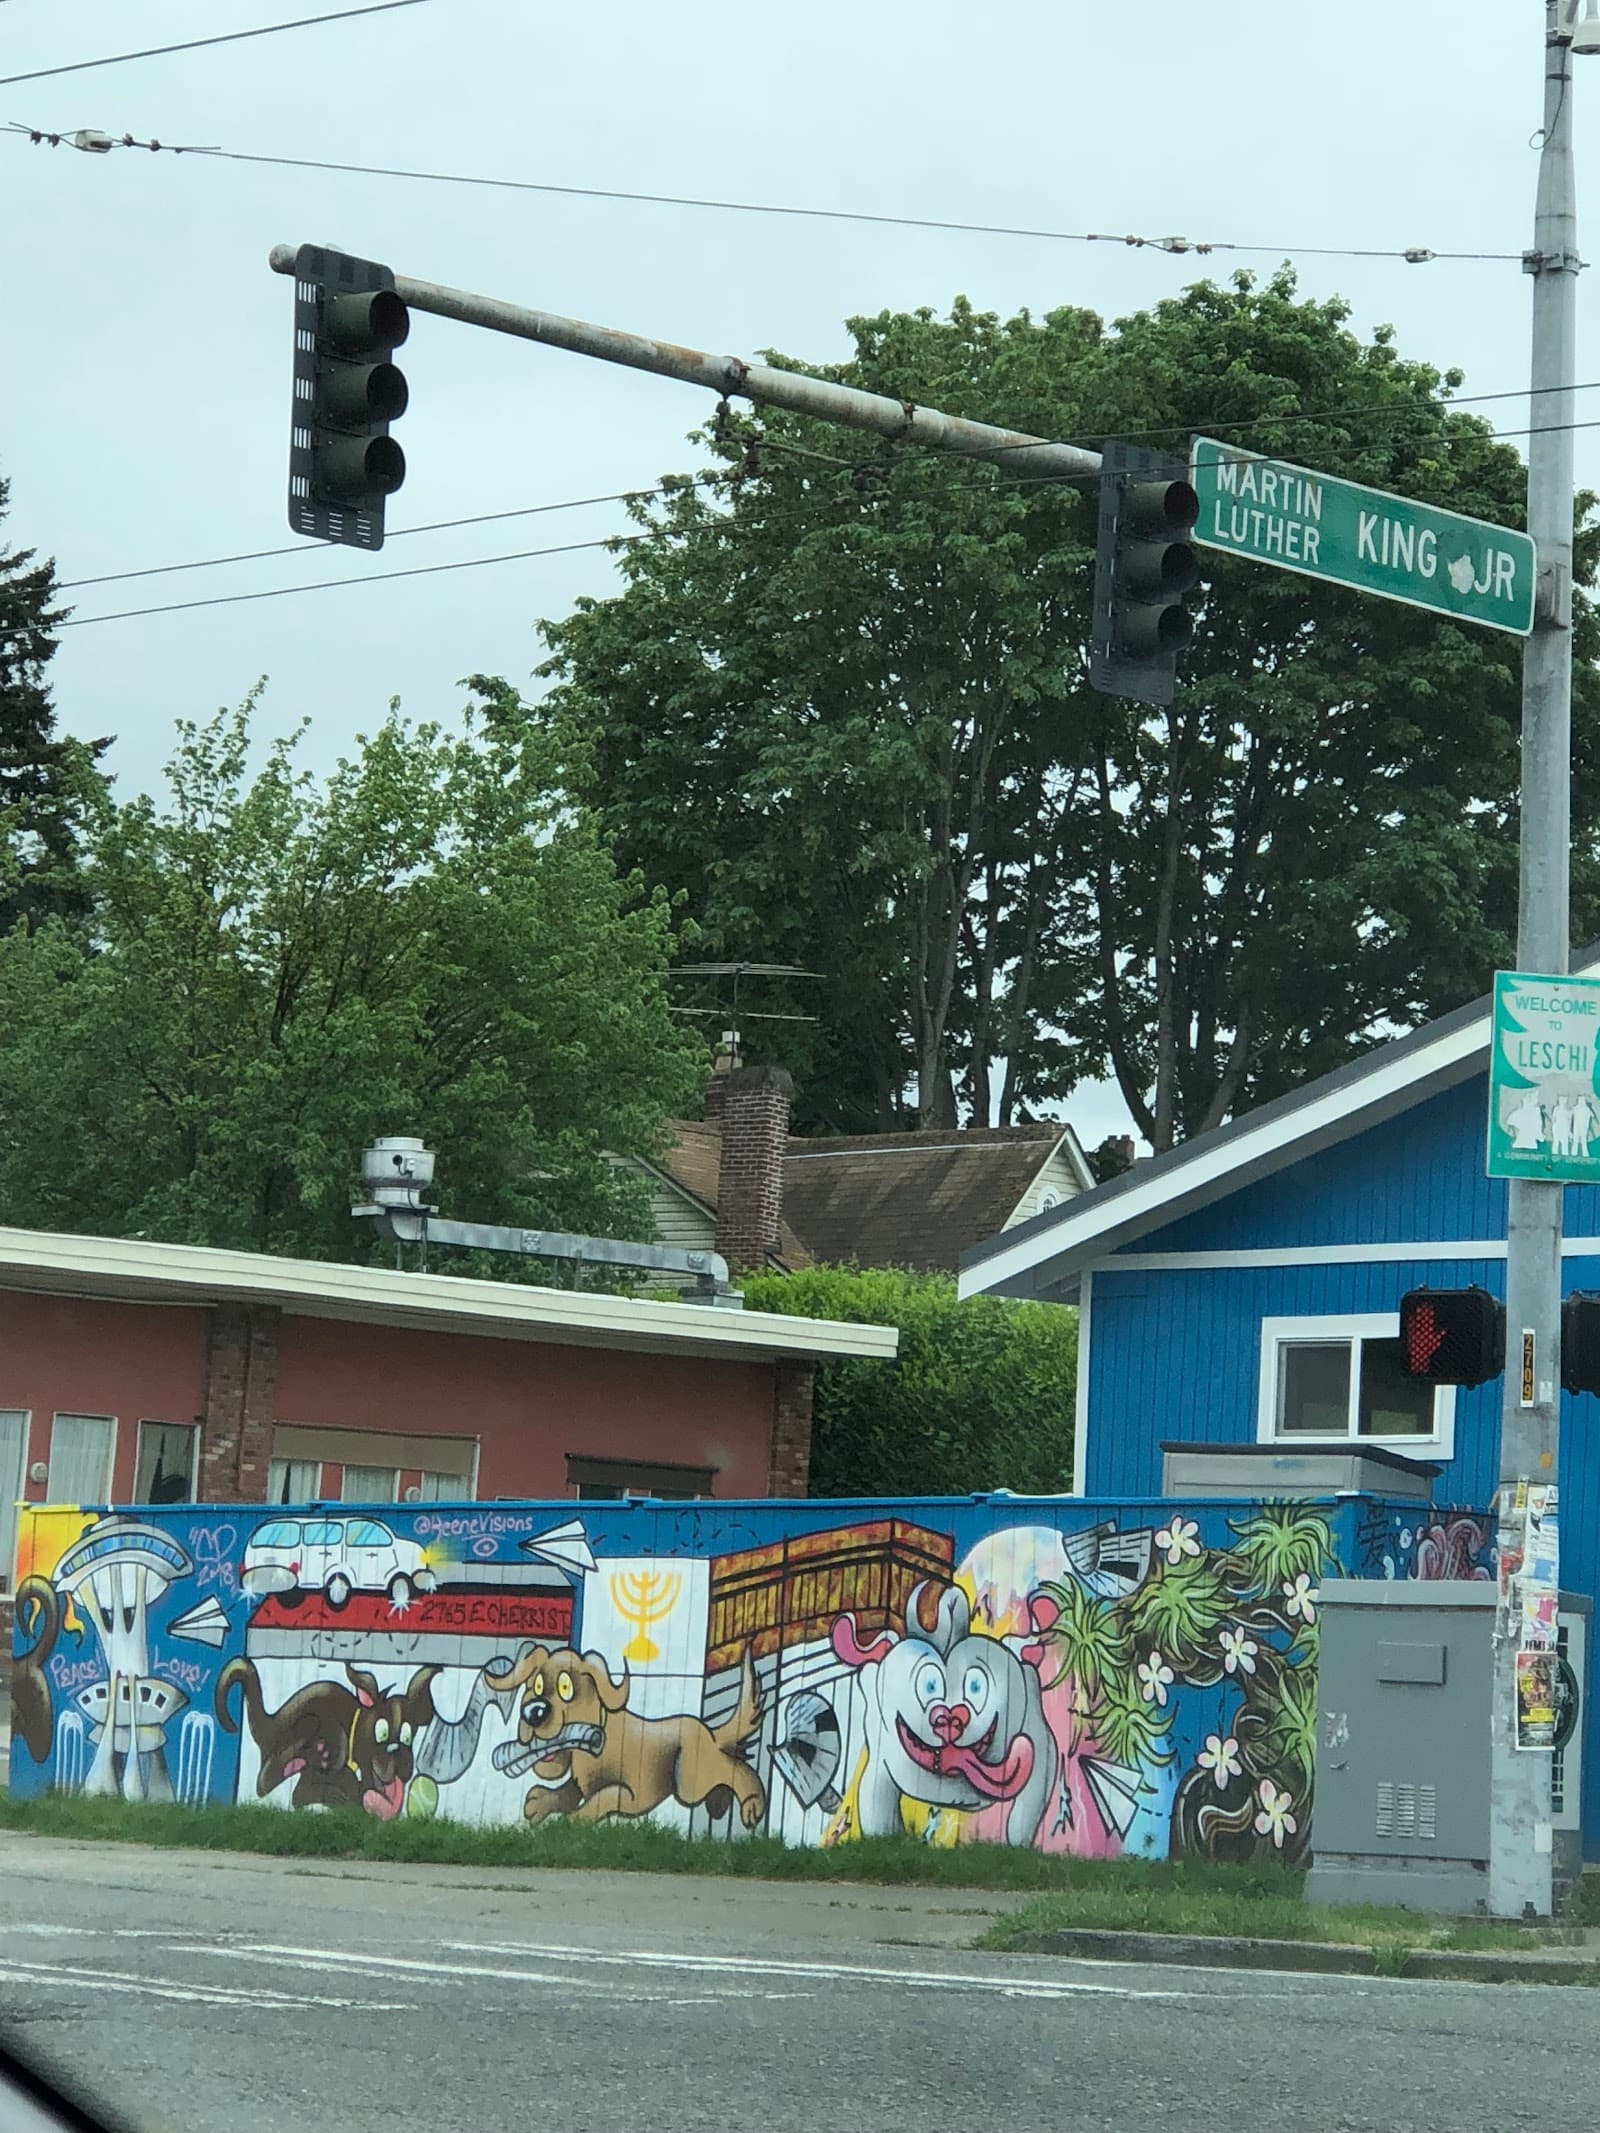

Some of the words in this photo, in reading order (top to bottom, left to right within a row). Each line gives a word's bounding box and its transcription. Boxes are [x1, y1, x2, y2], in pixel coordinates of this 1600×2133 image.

[1217, 455, 1322, 521] MARTIN
[1215, 499, 1320, 565] LUTHER
[1358, 511, 1437, 578] KING
[1474, 548, 1516, 601] JR
[1516, 995, 1597, 1015] WELCOME
[1548, 1020, 1562, 1031] TO
[1519, 1040, 1587, 1072] LESCHI
[1523, 1334, 1533, 1400] 2709
[420, 1600, 466, 1625] 2765
[470, 1600, 486, 1623] E
